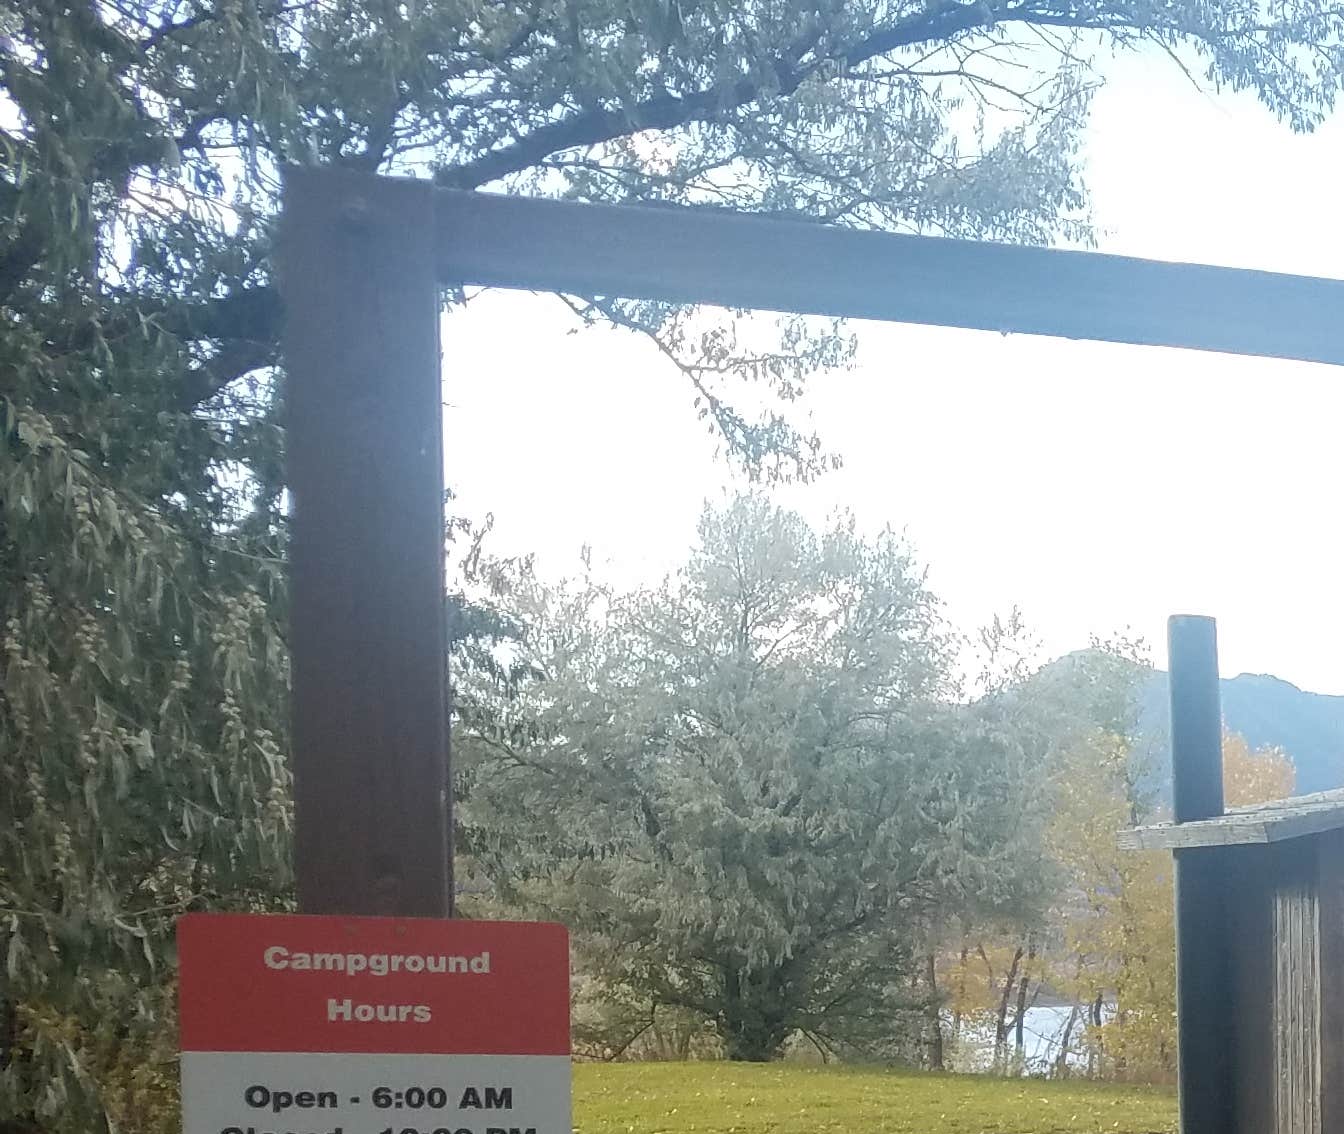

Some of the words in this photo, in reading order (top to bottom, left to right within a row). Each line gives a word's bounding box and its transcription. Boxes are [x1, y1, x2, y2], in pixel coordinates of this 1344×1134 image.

[263, 946, 490, 976] Campground
[327, 999, 432, 1023] Hours
[244, 1085, 338, 1113] Open
[371, 1086, 448, 1109] 6:00
[458, 1087, 513, 1110] AM
